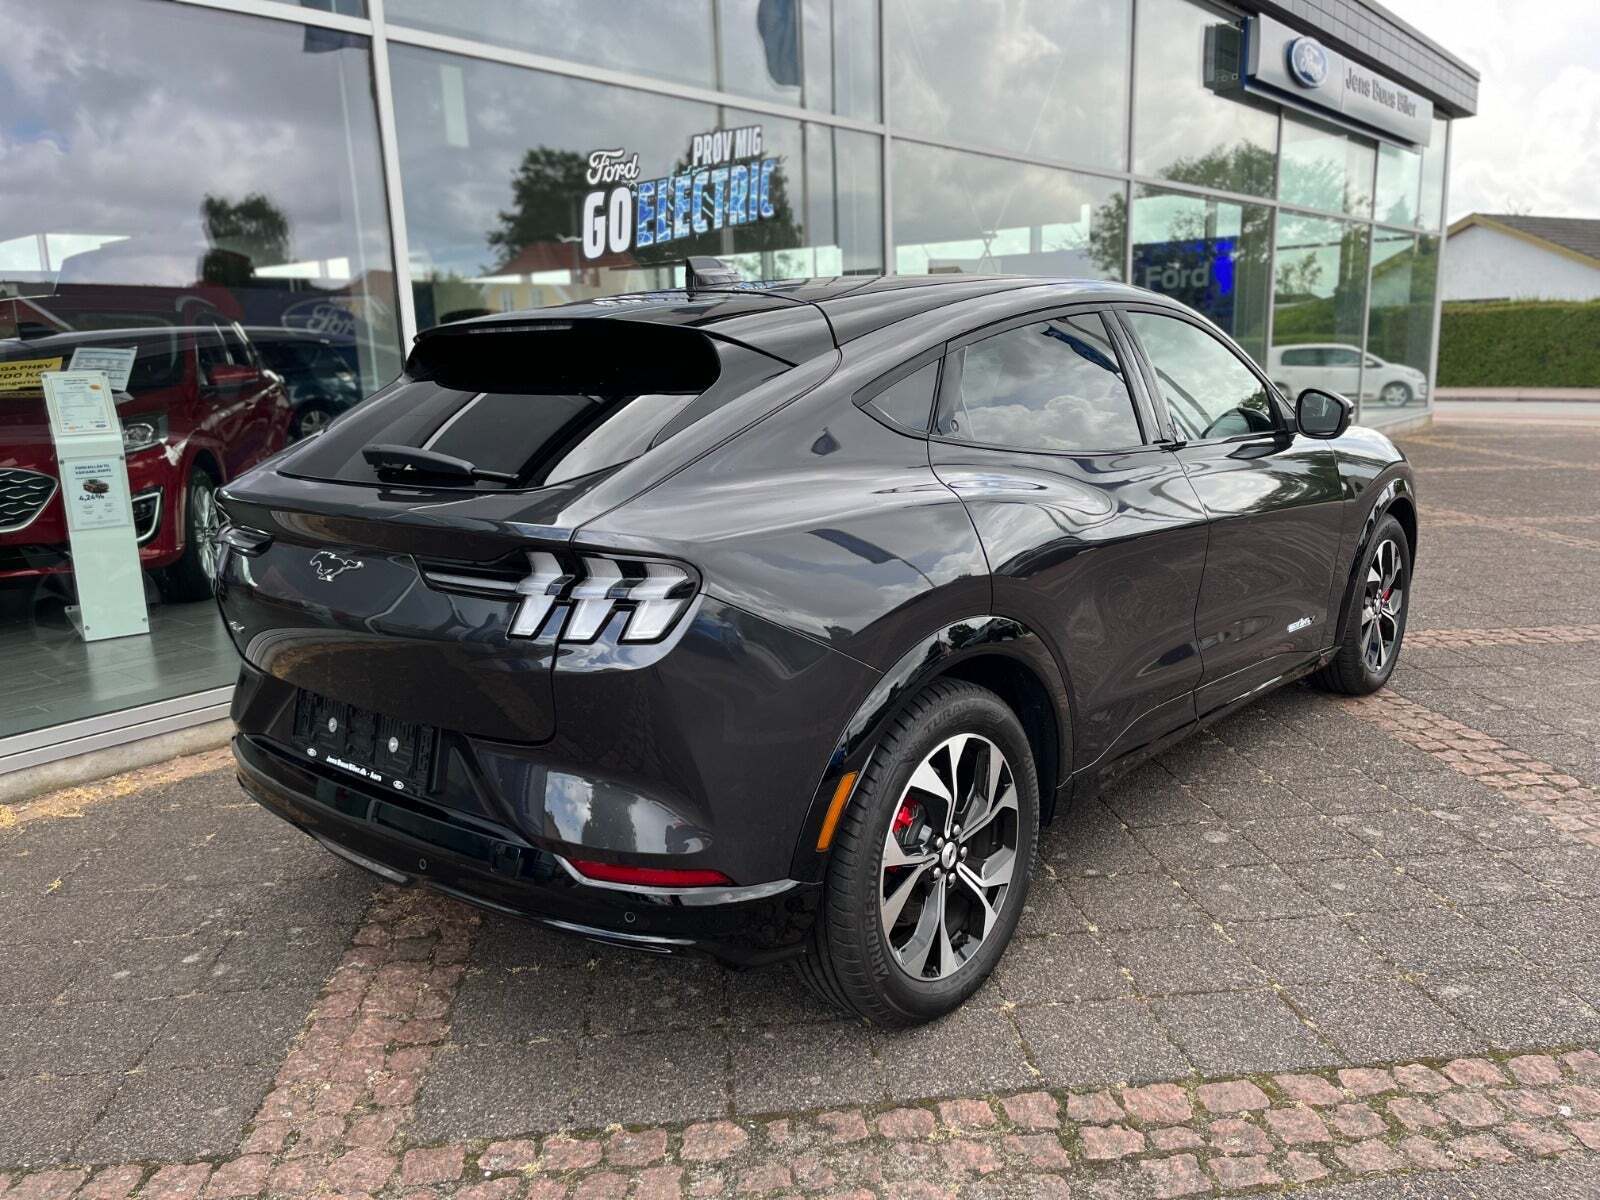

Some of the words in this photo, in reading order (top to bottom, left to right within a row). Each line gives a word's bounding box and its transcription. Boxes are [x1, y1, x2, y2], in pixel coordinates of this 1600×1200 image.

[1345, 67, 1370, 97] Jens
[693, 131, 732, 167] PRØV
[735, 126, 762, 158] MIG
[586, 149, 639, 184] Ford
[583, 187, 632, 259] GO
[636, 158, 777, 248] ELECTRIC
[1144, 261, 1210, 290] Ford
